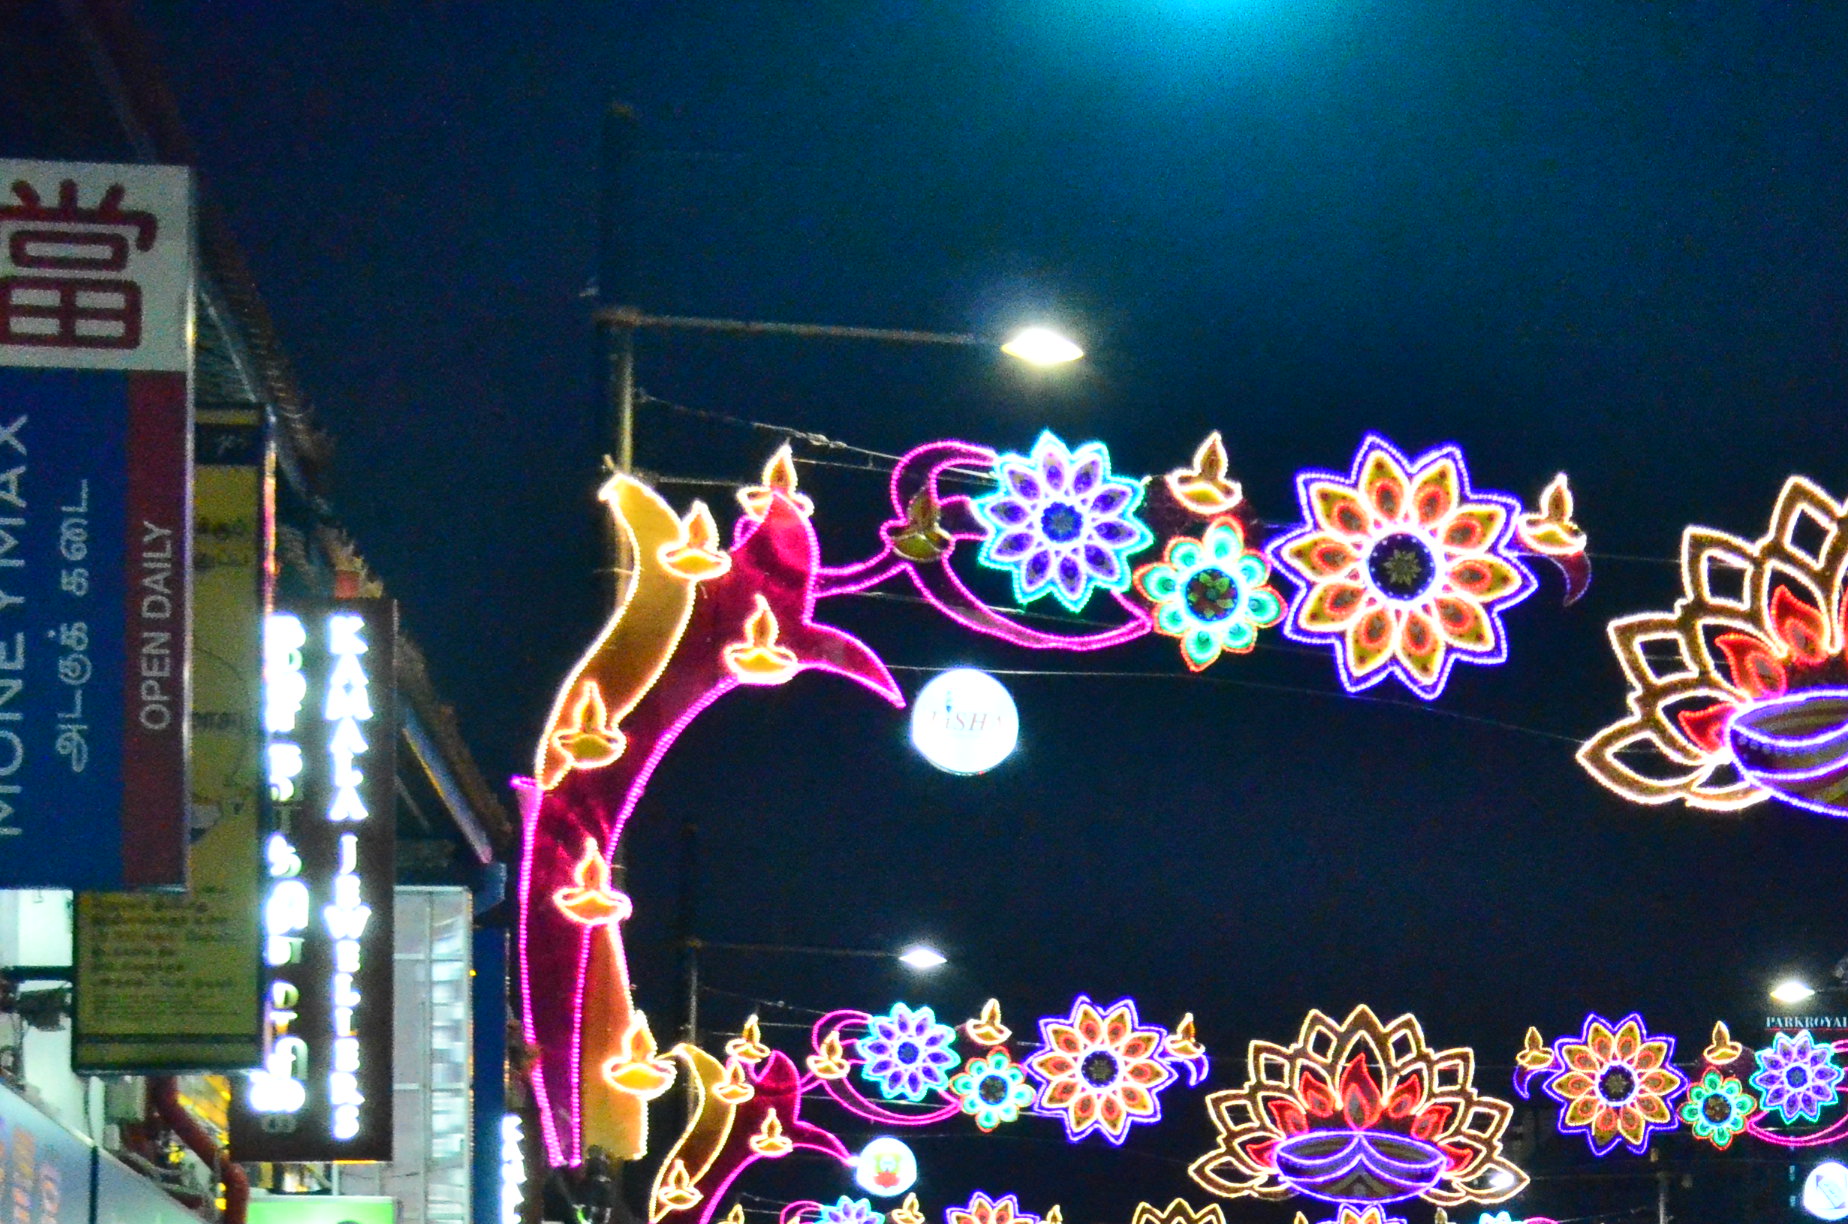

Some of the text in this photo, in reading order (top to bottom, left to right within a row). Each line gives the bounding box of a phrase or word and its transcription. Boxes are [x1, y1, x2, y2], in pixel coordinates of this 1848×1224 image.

[138, 520, 174, 731] OPEN DAILY
[324, 833, 373, 1140] JEWELLERS
